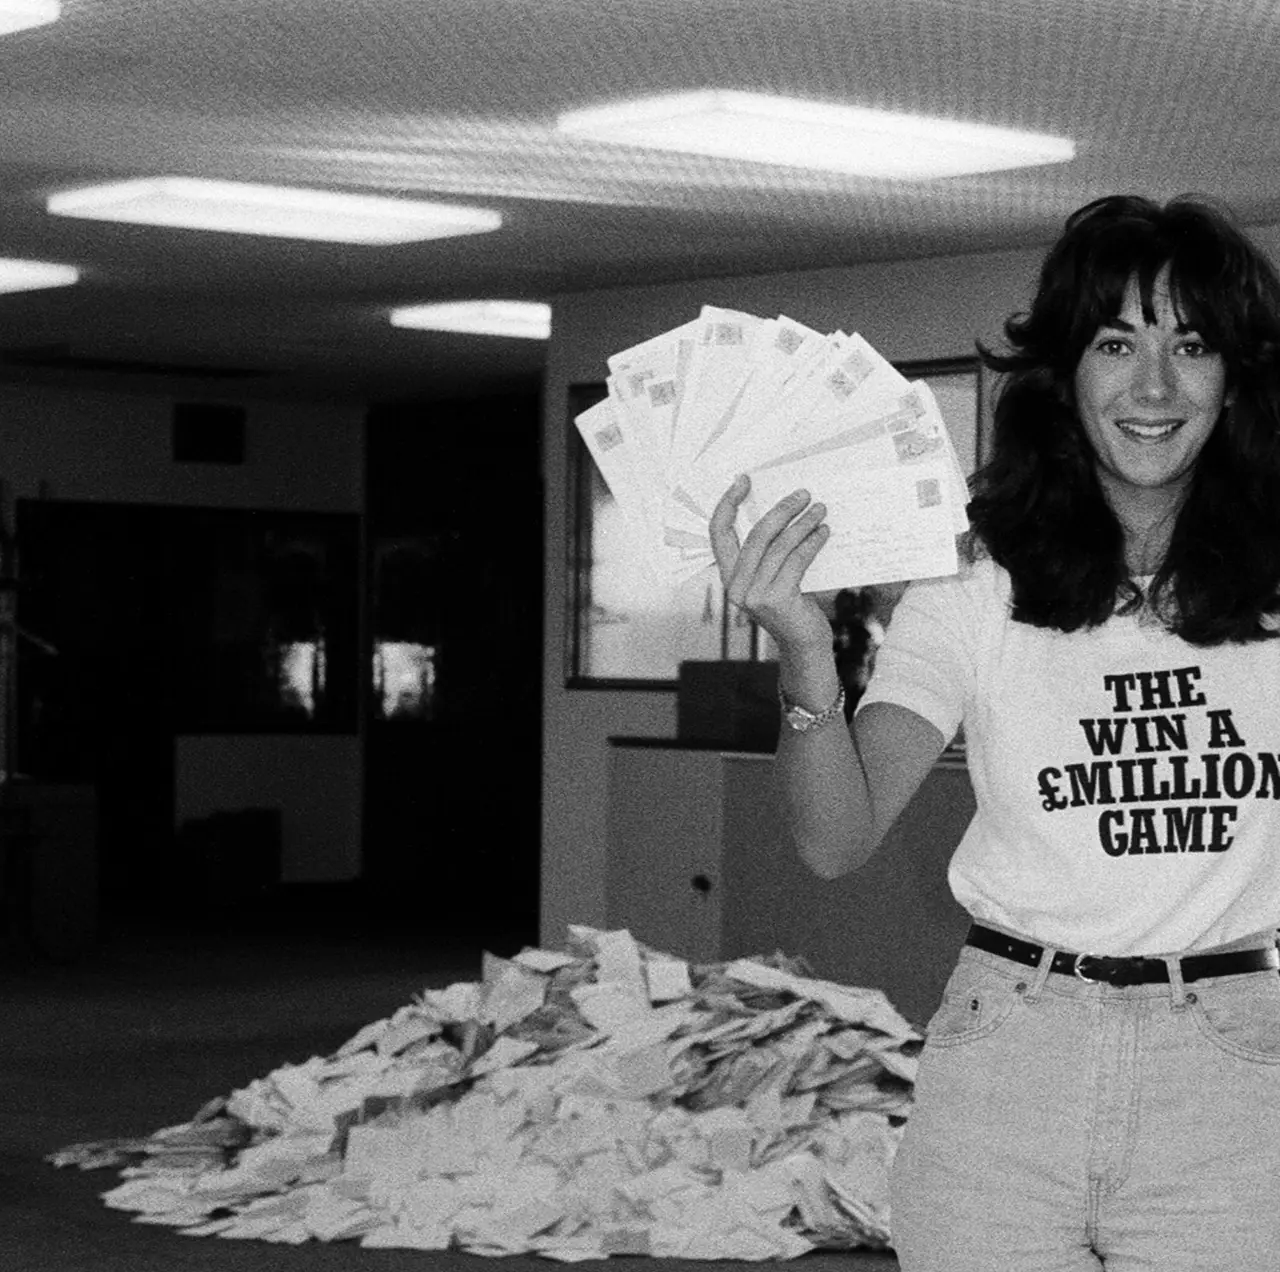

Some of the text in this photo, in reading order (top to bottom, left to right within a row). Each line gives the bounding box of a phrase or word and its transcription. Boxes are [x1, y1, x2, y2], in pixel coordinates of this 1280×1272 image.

[1103, 665, 1207, 713] THE
[1078, 708, 1246, 756] WIN A
[1098, 805, 1238, 857] GAME
